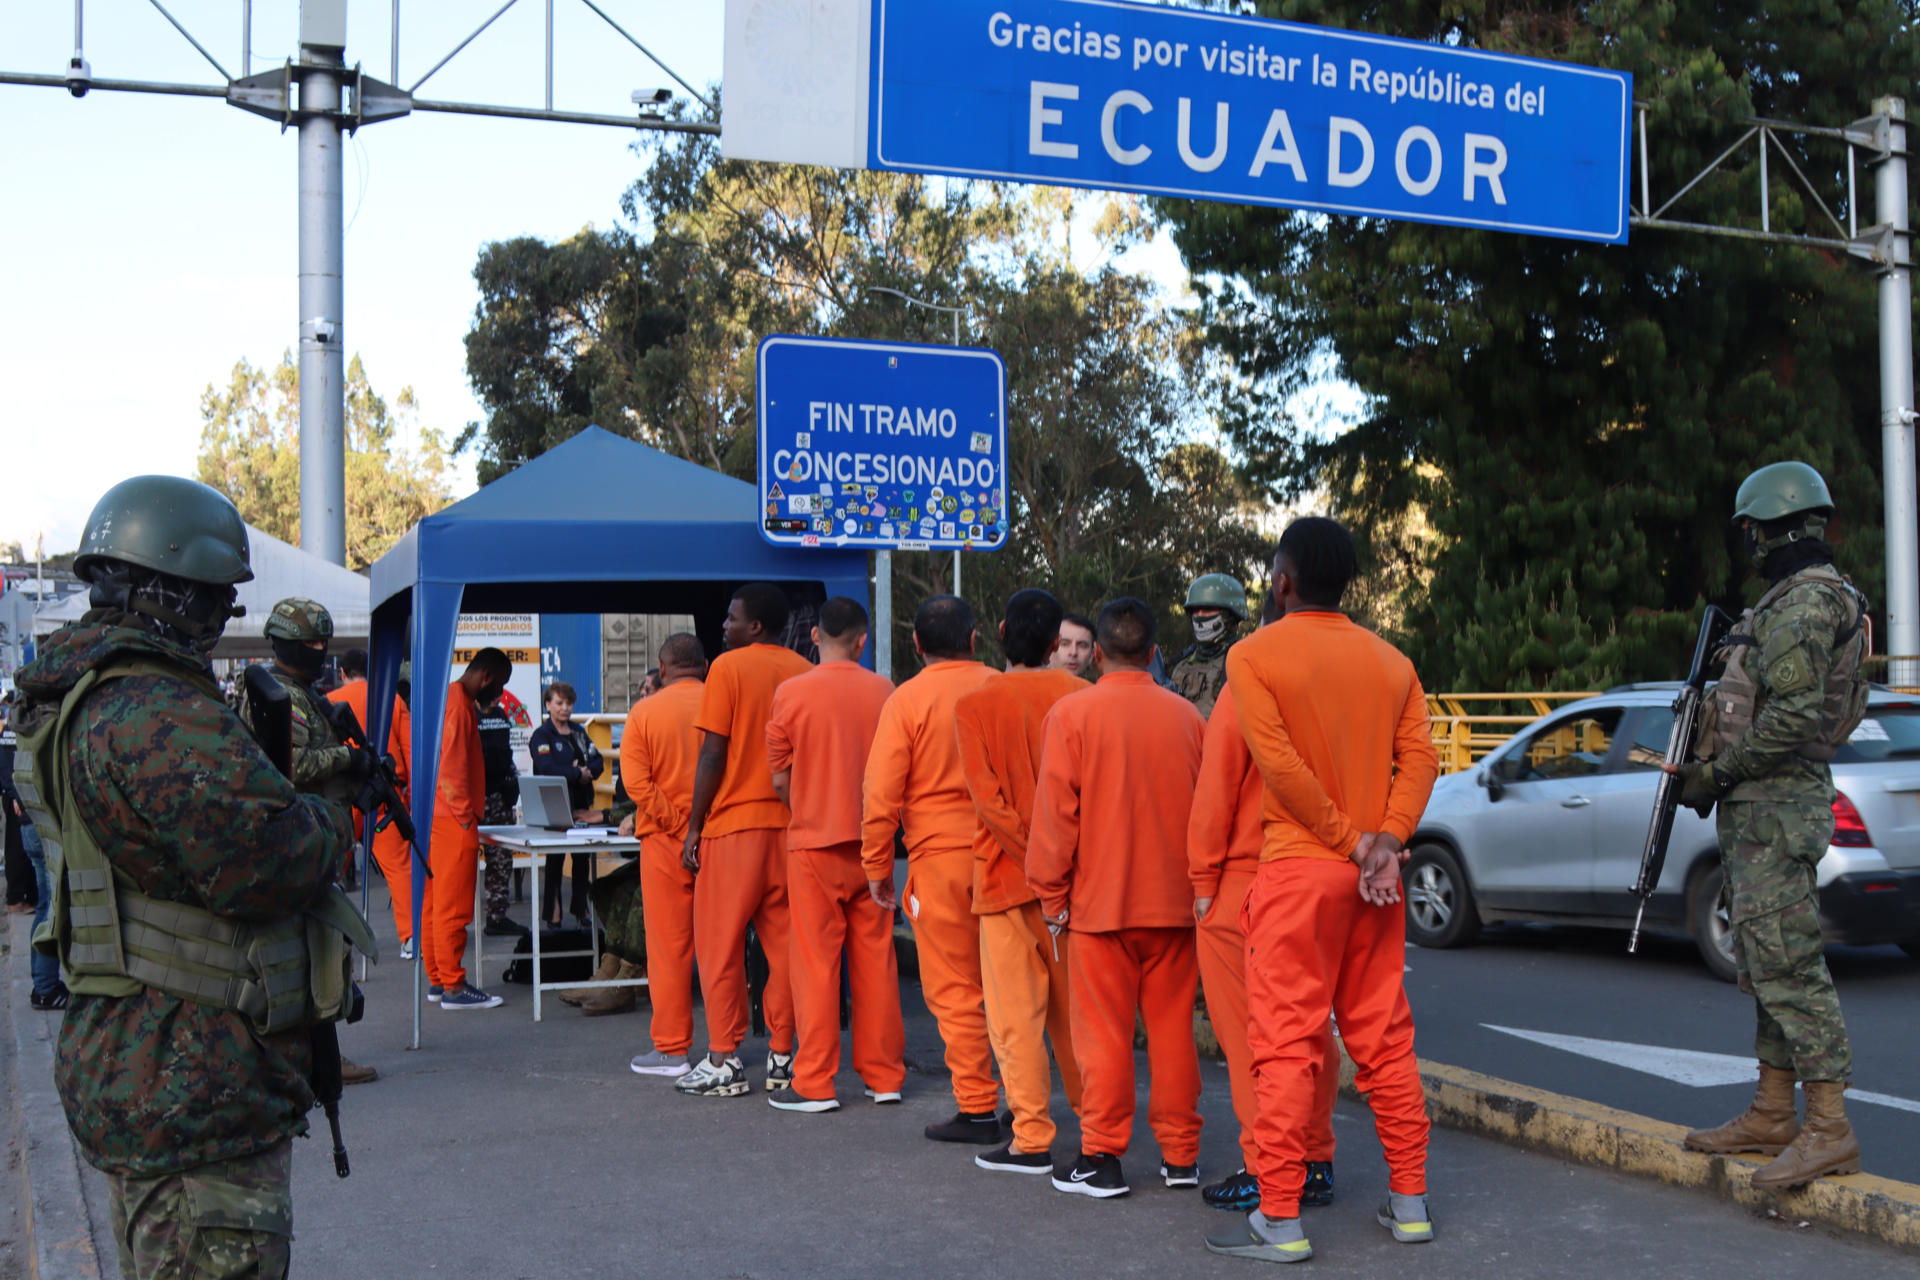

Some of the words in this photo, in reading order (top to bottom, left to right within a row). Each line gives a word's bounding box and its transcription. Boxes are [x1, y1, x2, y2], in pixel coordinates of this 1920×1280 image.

[988, 11, 1121, 60] Gracias
[1133, 37, 1189, 71] por
[1200, 40, 1301, 82] visitar
[1312, 53, 1337, 88] la
[1350, 58, 1495, 109] República
[1504, 81, 1545, 116] del
[1029, 80, 1508, 205] ECUADOR
[809, 401, 853, 433] FIN
[859, 404, 957, 438] TRAMO
[773, 449, 995, 488] CONCESIONADO
[457, 622, 533, 631] GROPECUARIOS
